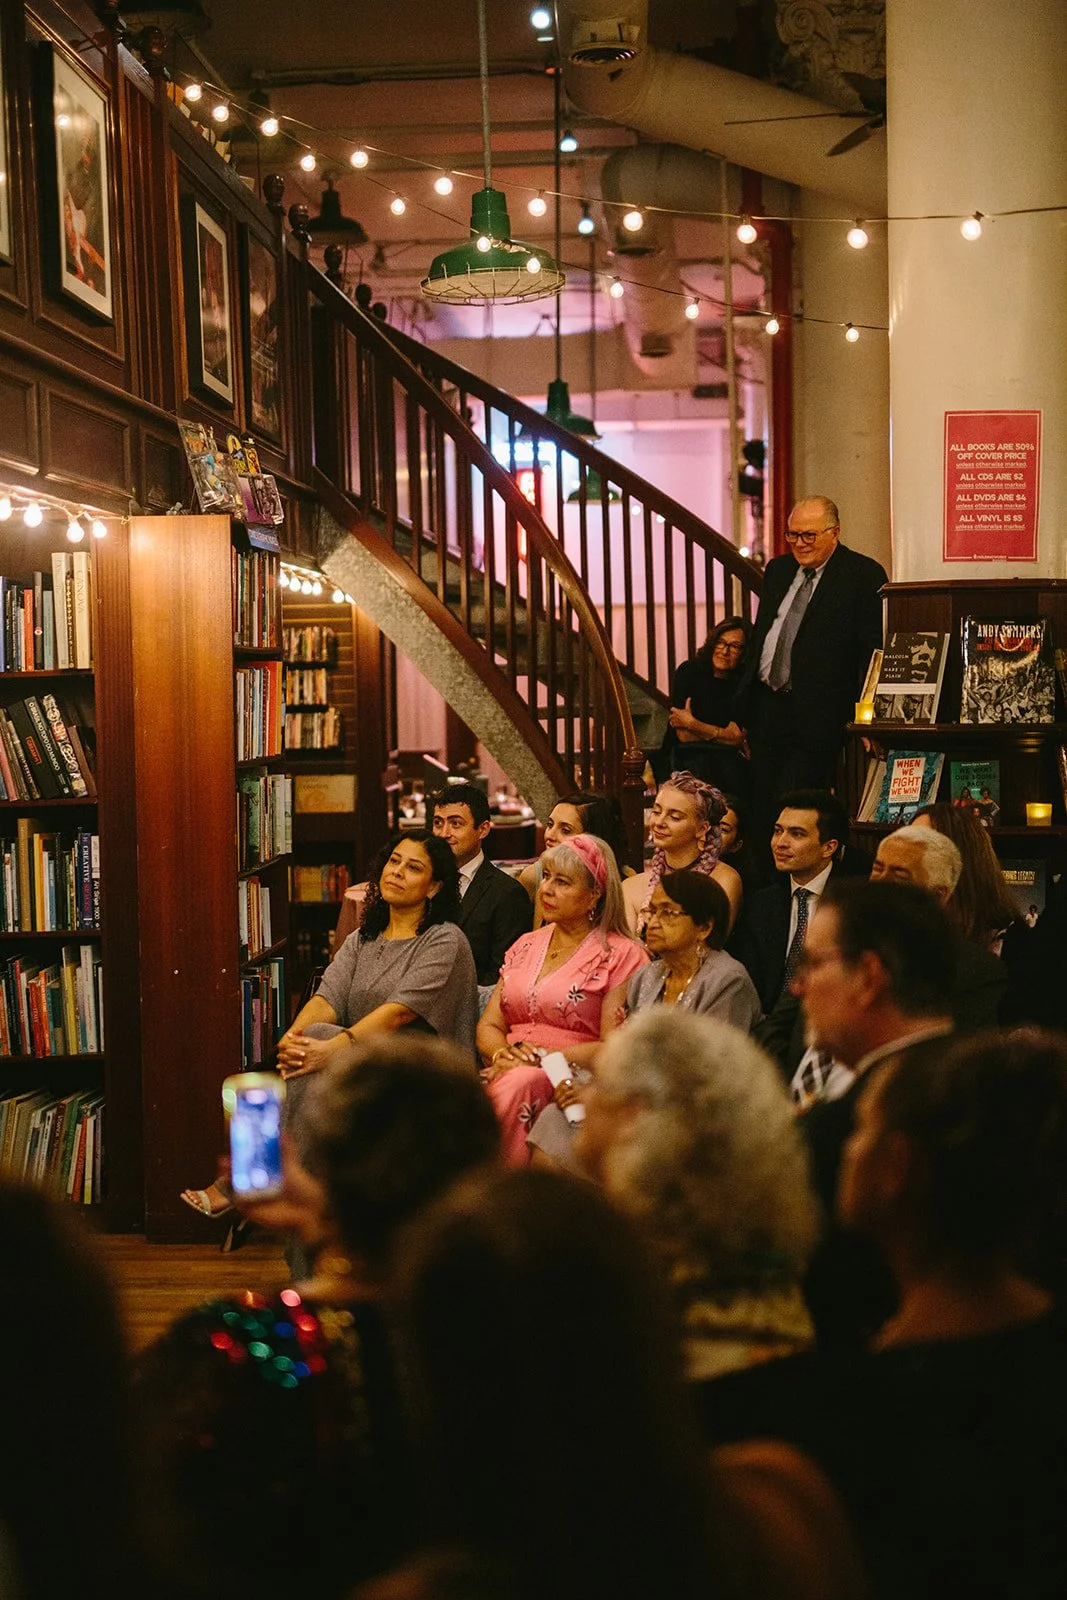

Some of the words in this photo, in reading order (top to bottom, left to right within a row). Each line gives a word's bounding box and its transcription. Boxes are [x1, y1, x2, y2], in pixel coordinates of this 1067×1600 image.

[950, 443, 965, 451] ALL
[967, 443, 995, 451] BOOKS
[957, 452, 973, 460] OFF
[975, 452, 1002, 460] COVER
[977, 514, 1002, 522] VINYL
[977, 624, 999, 637] ANDY
[1000, 624, 1041, 639] SUMMERS
[45, 743, 52, 752] DO
[896, 759, 921, 768] WHEN
[902, 768, 914, 776] WE
[892, 777, 921, 787] FIGHT
[903, 786, 919, 795] WIN!
